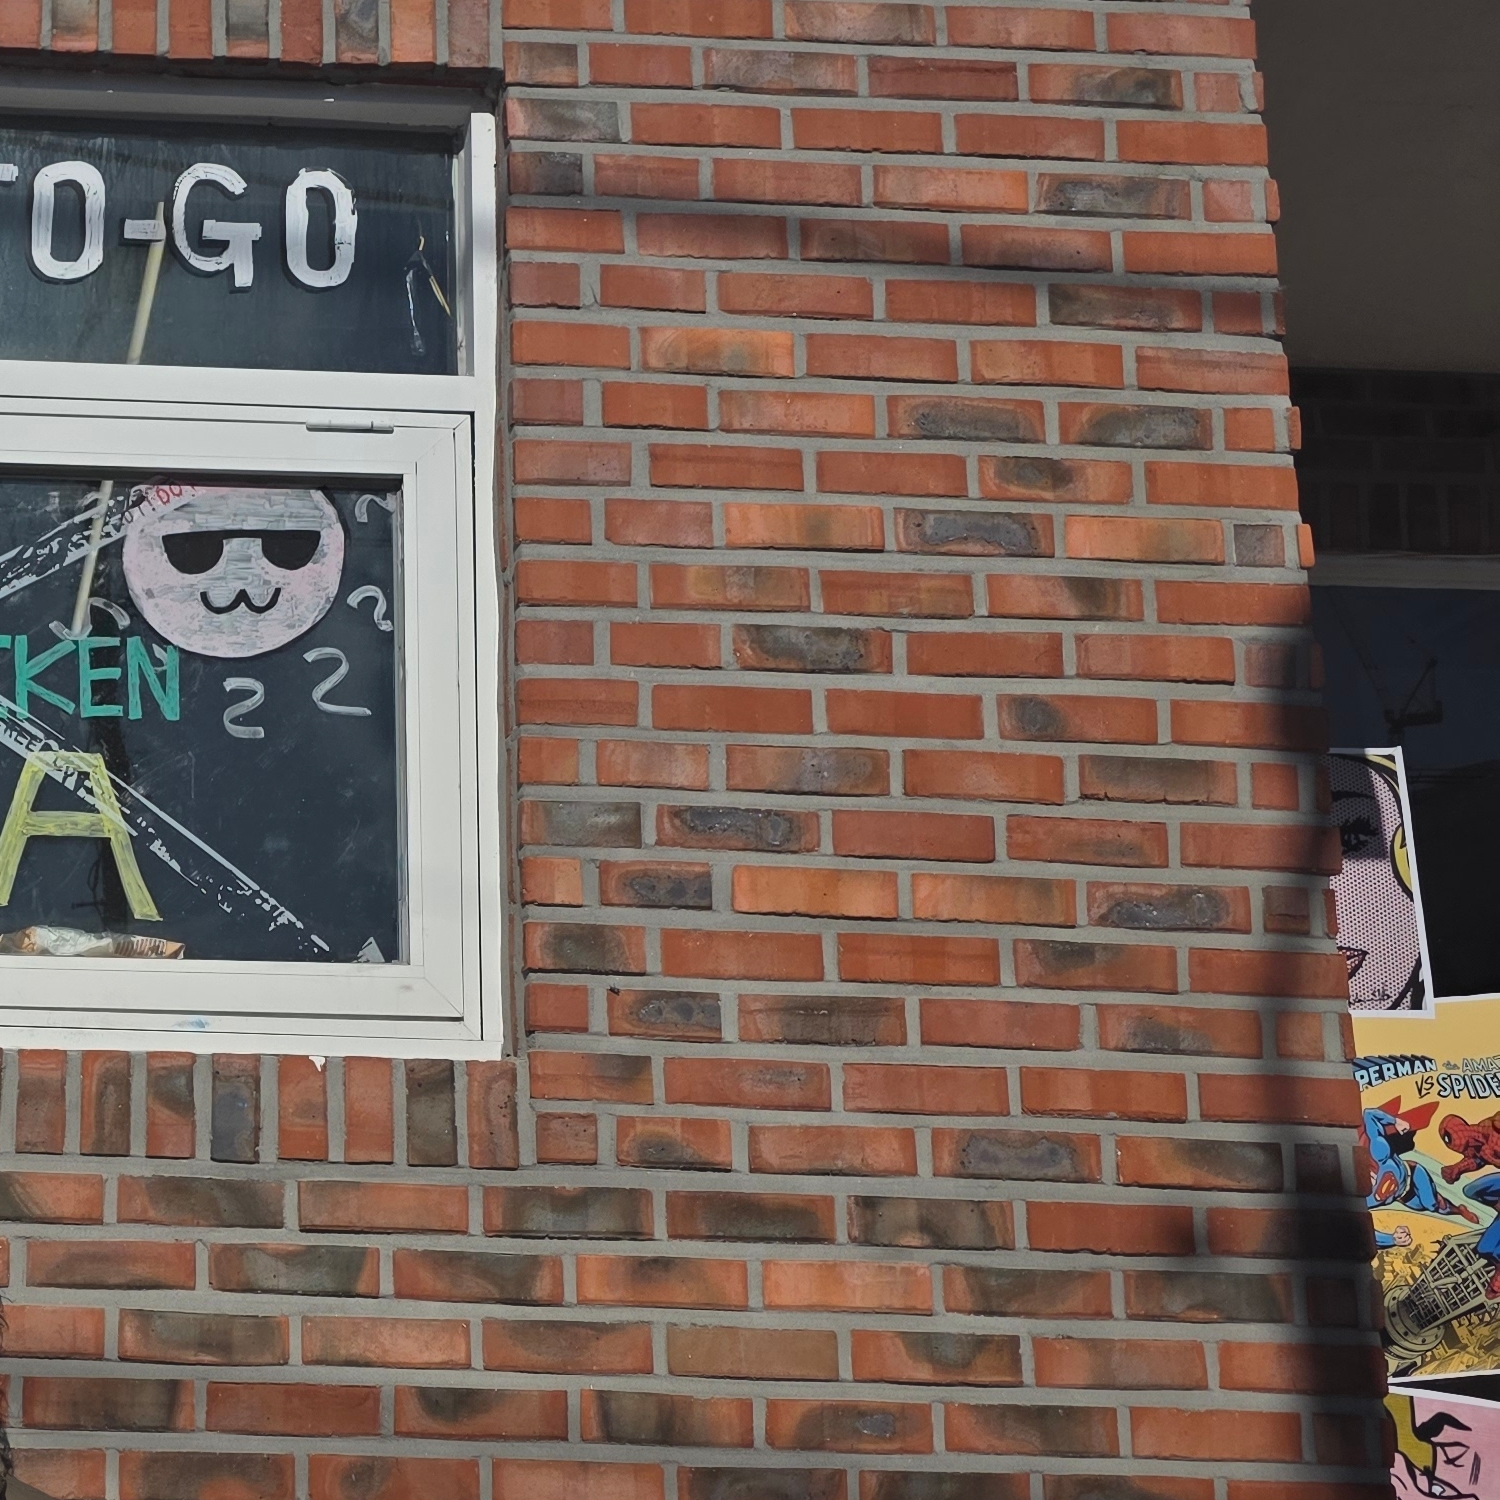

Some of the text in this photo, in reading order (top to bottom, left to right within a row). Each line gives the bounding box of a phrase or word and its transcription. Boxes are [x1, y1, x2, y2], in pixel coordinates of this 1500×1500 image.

[1352, 1056, 1438, 1093] PERMAN
[1415, 1071, 1500, 1099] VS SPIDE
